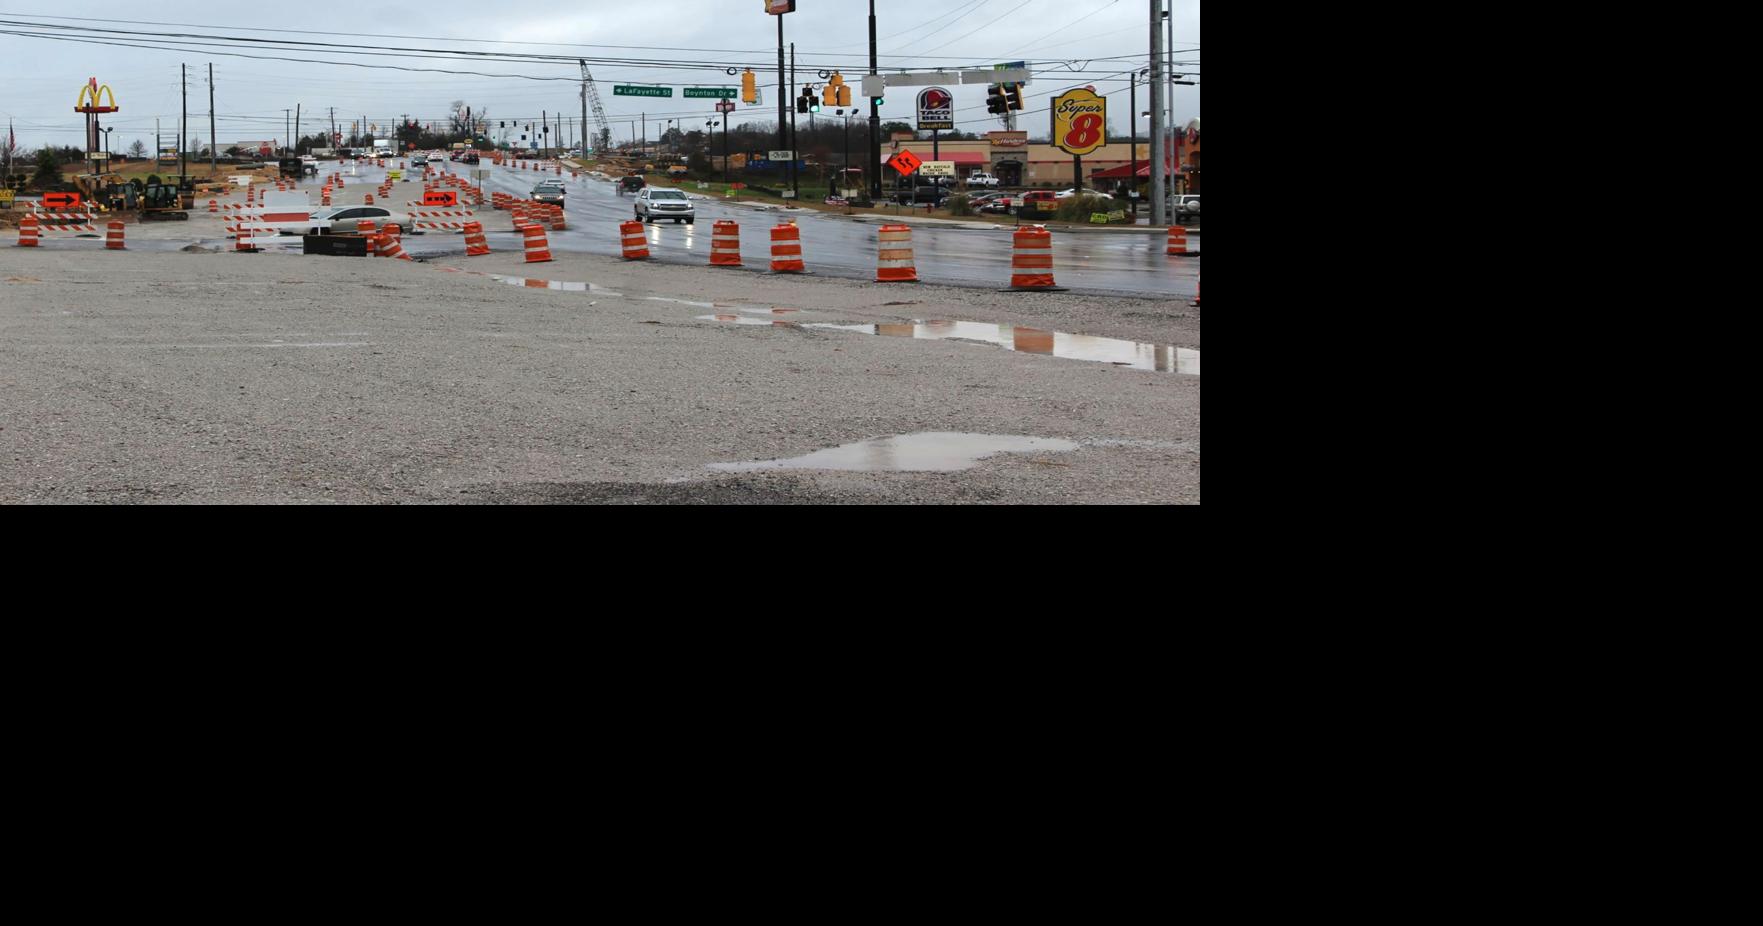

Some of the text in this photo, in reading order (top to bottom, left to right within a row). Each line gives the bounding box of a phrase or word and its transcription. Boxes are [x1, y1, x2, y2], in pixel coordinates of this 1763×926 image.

[623, 87, 660, 96] LaFayette
[684, 89, 715, 97] Boynton
[1056, 98, 1103, 120] Super
[1062, 113, 1103, 149] 8
